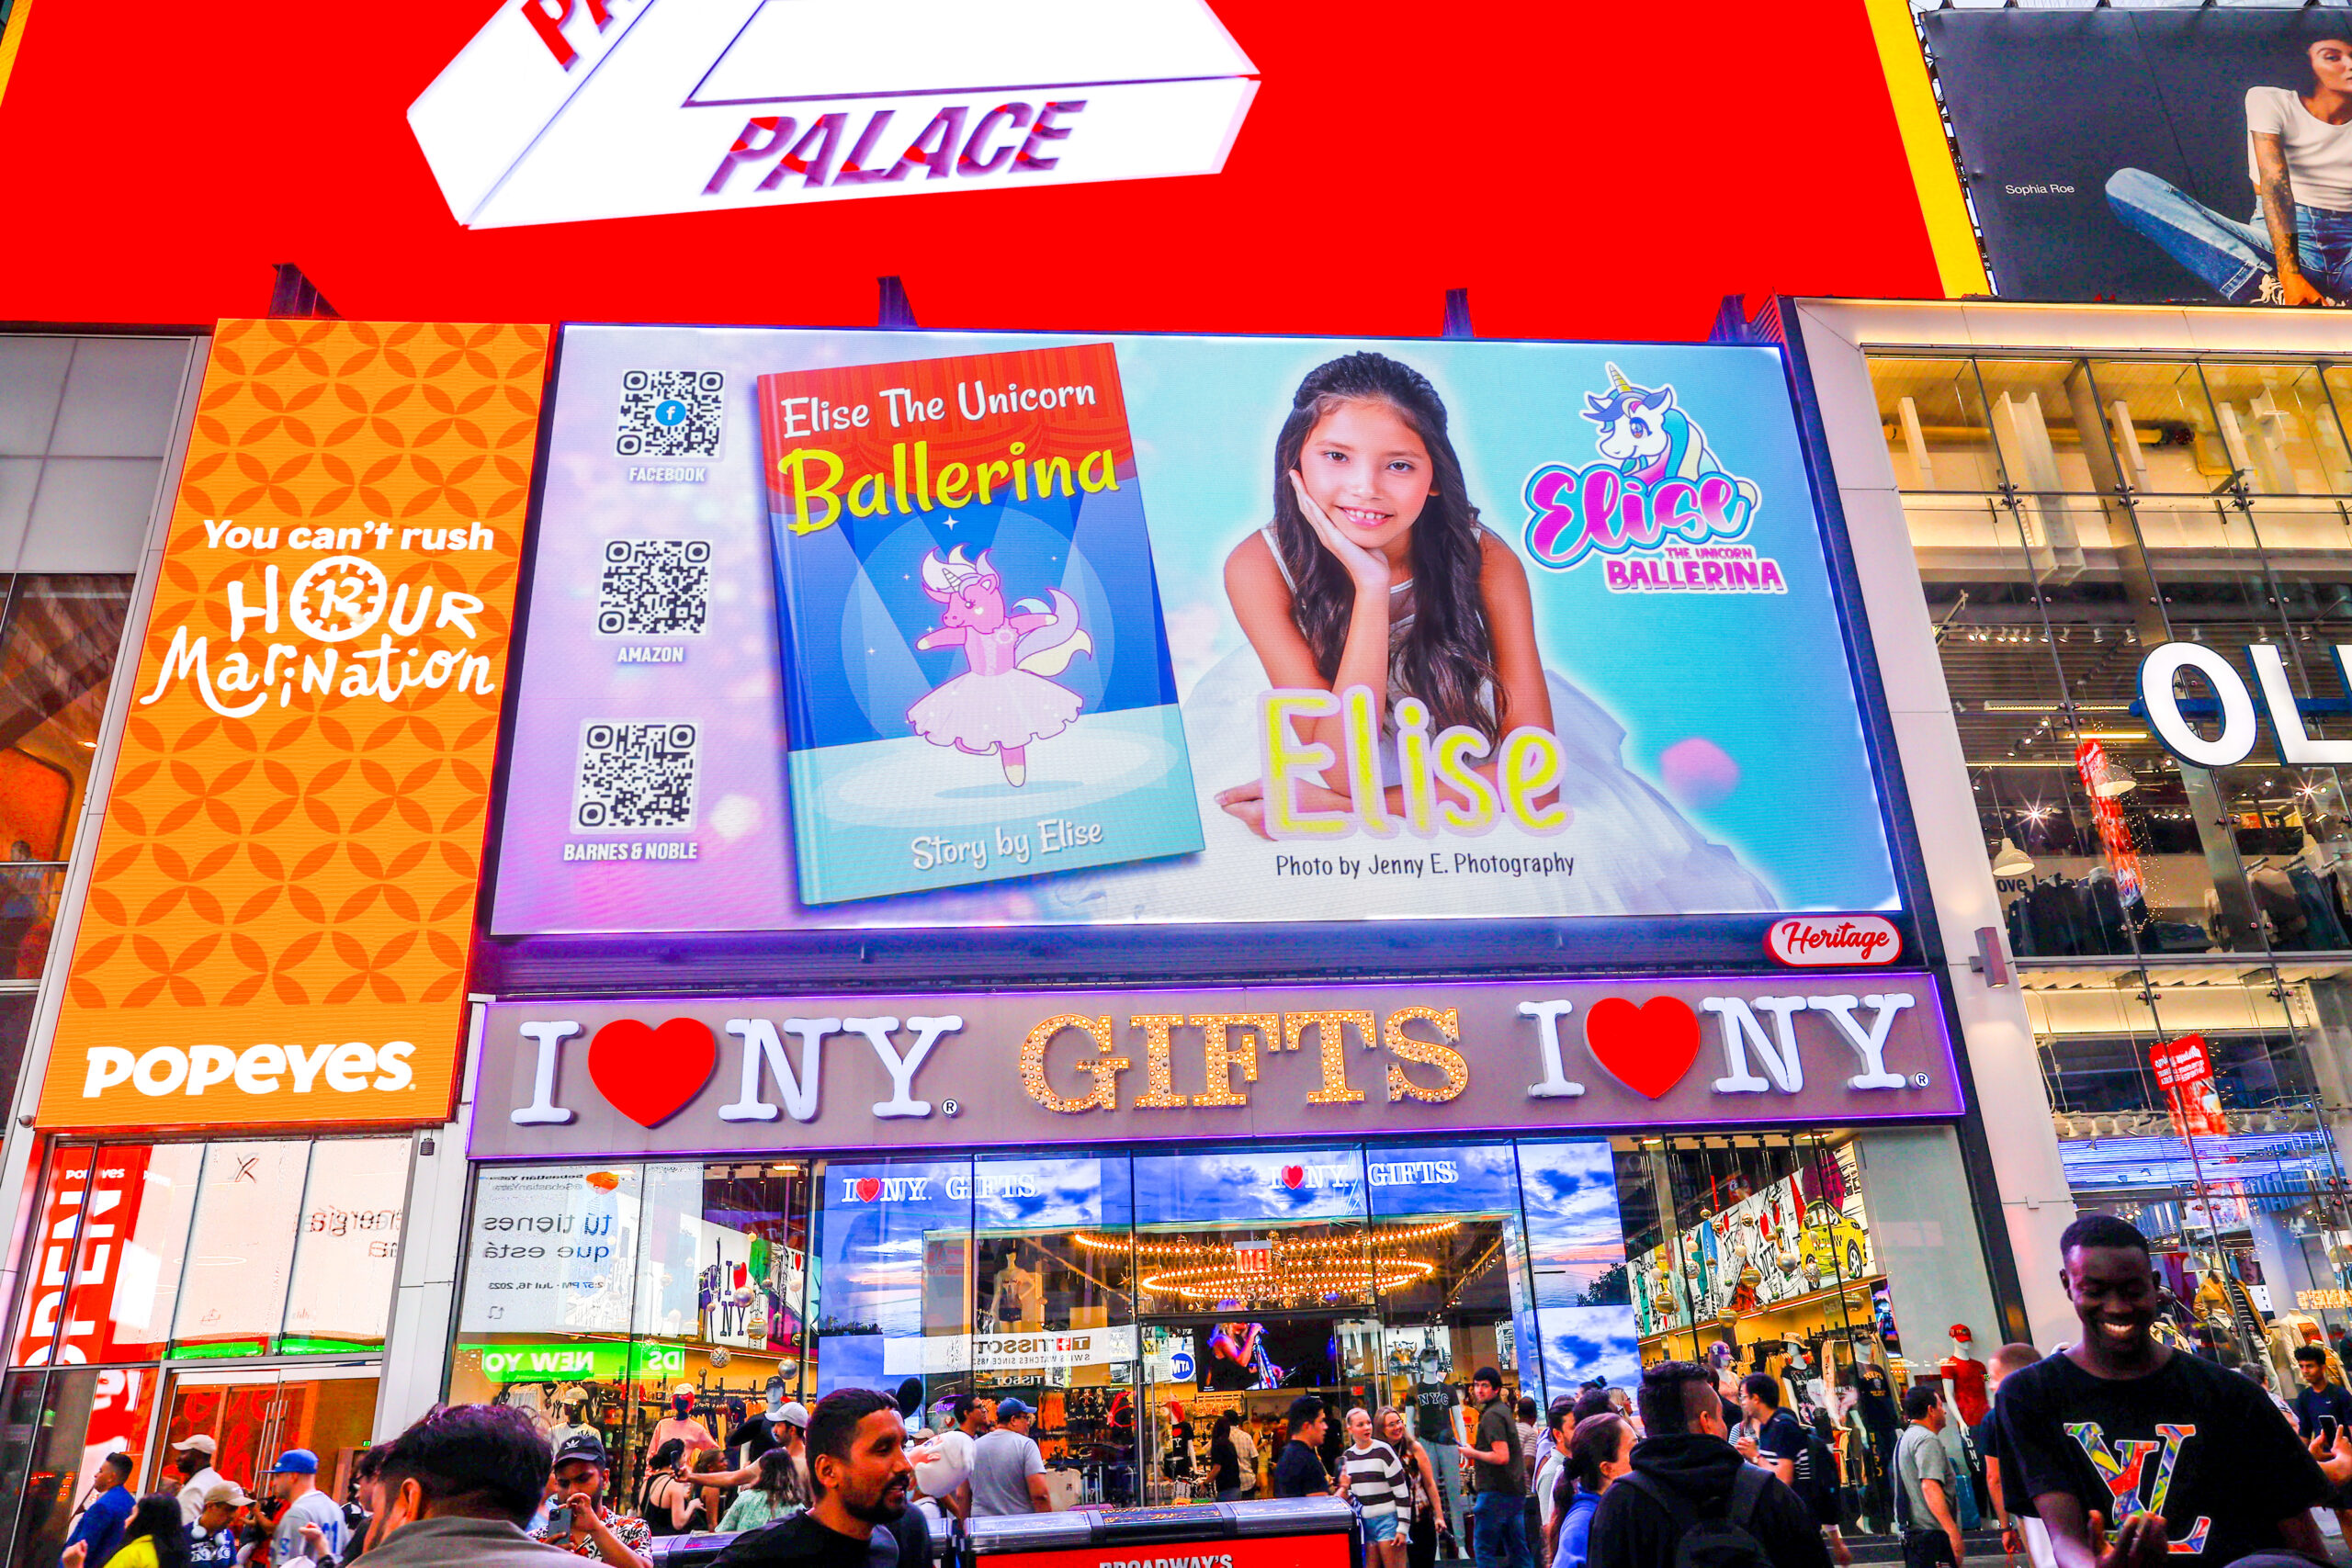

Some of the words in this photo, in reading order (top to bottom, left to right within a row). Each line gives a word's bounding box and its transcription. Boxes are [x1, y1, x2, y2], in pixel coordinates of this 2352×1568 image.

[700, 99, 1088, 196] PALACE
[2005, 185, 2048, 196] Sophia
[2050, 184, 2075, 193] Roe
[781, 397, 870, 439] Elise
[879, 387, 946, 428] The
[957, 379, 1097, 422] Unicorn
[628, 468, 706, 482] FACEBOOK
[776, 441, 1121, 536] Ballerina
[1530, 468, 1746, 563] Elise
[203, 519, 278, 549] You
[288, 520, 393, 549] can't
[401, 522, 494, 551] rush
[1665, 547, 1691, 559] THE
[1696, 547, 1752, 558] UNICORN
[1607, 560, 1785, 591] BALLERINA
[617, 647, 684, 662] AMAZON
[1261, 687, 1572, 838] Elise
[563, 843, 628, 861] BARNES
[630, 843, 643, 860] &
[645, 842, 698, 860] NOBLE
[910, 835, 989, 872] Story
[995, 825, 1031, 864] by
[1036, 818, 1103, 853] Elise
[1275, 854, 1333, 876] Photo
[1340, 854, 1361, 879] by
[1368, 854, 1424, 878] Jenny
[1430, 852, 1449, 874] E.
[1454, 852, 1575, 877] Photography
[1781, 921, 1890, 960] Heritage
[510, 1021, 582, 1126] I
[718, 1014, 963, 1123] NY
[1020, 1005, 1469, 1114] GIFTS
[1514, 999, 1586, 1099] I
[1697, 992, 1917, 1095] NY
[1367, 1160, 1456, 1186] GIFTS
[944, 1175, 1036, 1201] GIFTS
[1171, 1359, 1191, 1374] MTA
[1418, 1393, 1449, 1406] NYC
